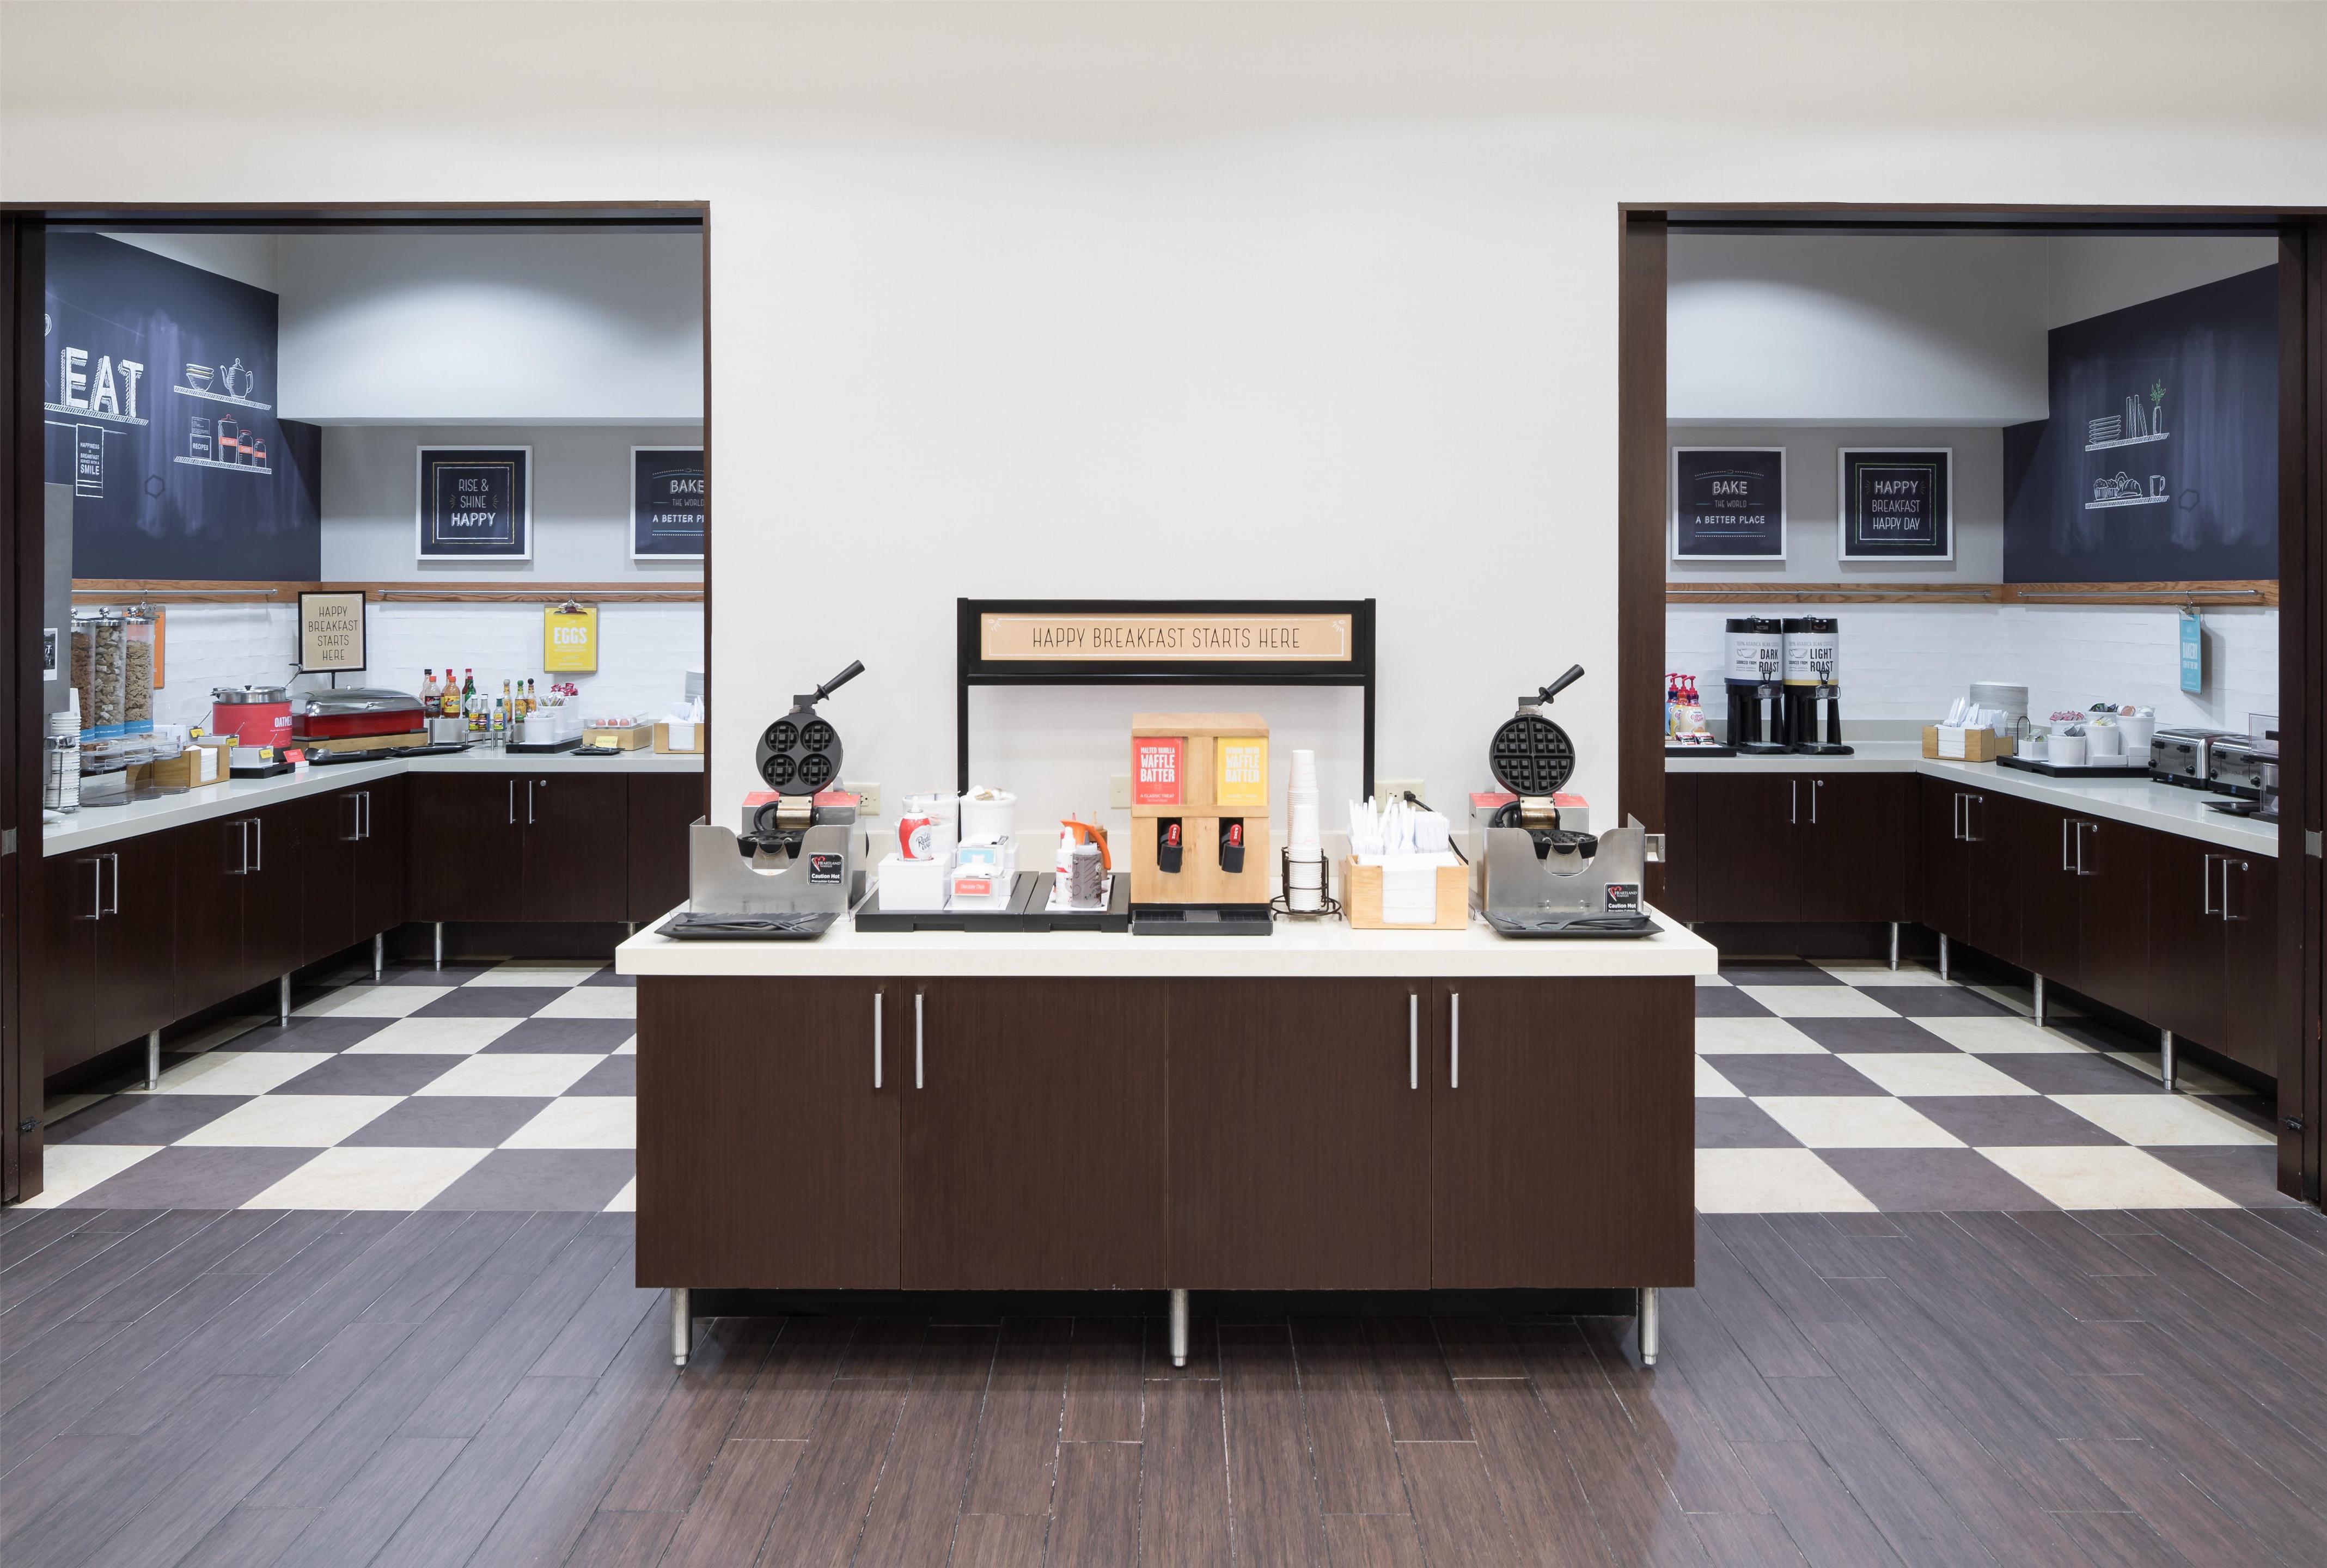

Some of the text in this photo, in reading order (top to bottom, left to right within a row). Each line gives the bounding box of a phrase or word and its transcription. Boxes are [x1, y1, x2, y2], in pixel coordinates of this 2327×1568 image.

[61, 347, 144, 418] EAT
[193, 443, 209, 451] RECIPES
[80, 464, 100, 475] SMILE
[459, 479, 488, 491] RISE &
[670, 480, 704, 494] BAKE
[1712, 481, 1748, 495] BAKE
[1874, 481, 1919, 494] HAPPY
[460, 495, 487, 508] SHINE
[1872, 500, 1920, 512] BREAKFAST
[451, 512, 496, 526] HAPPY
[653, 514, 658, 523] A
[662, 514, 693, 523] BETTER
[1695, 516, 1765, 524] A BETTER PLACE
[1873, 517, 1920, 530] HAPPY DAY
[319, 606, 347, 617] HAPPY
[308, 620, 358, 632] BREAKFAST
[317, 634, 349, 647] STARTS
[553, 627, 587, 645] EGGS
[1033, 628, 1300, 648] HAPPY BREAKFAST STARTS HERE
[322, 649, 345, 661] HERE
[1761, 648, 1778, 659] DARK
[1810, 648, 1832, 659] LIGHT
[2183, 642, 2198, 659] BAKERY
[1759, 661, 1779, 672] ROAST
[1810, 661, 1833, 672] ROAST
[274, 716, 292, 728] OATME
[1141, 754, 1175, 768] WAFFLE
[1225, 754, 1259, 768] WAFFLE
[1140, 768, 1175, 782] BATTER
[1225, 768, 1260, 782] BATTER
